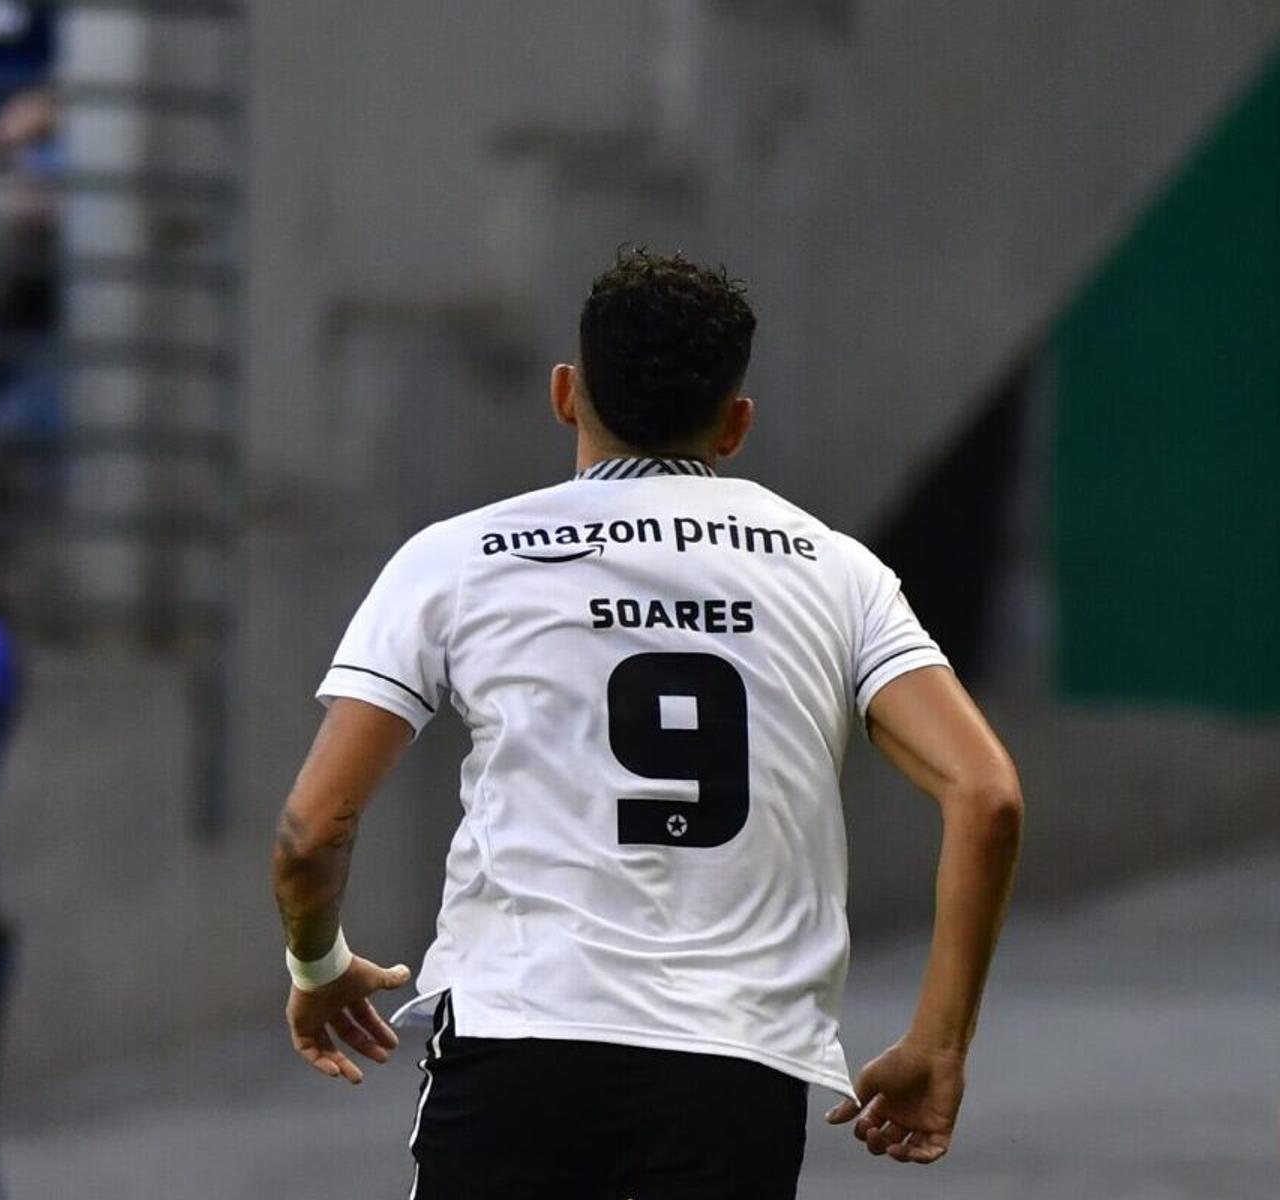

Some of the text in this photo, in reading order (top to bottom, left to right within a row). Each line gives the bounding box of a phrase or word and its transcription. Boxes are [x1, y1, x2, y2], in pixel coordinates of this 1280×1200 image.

[481, 515, 818, 562] amazon prime
[588, 598, 756, 634] SOARES
[606, 651, 751, 849] 9
